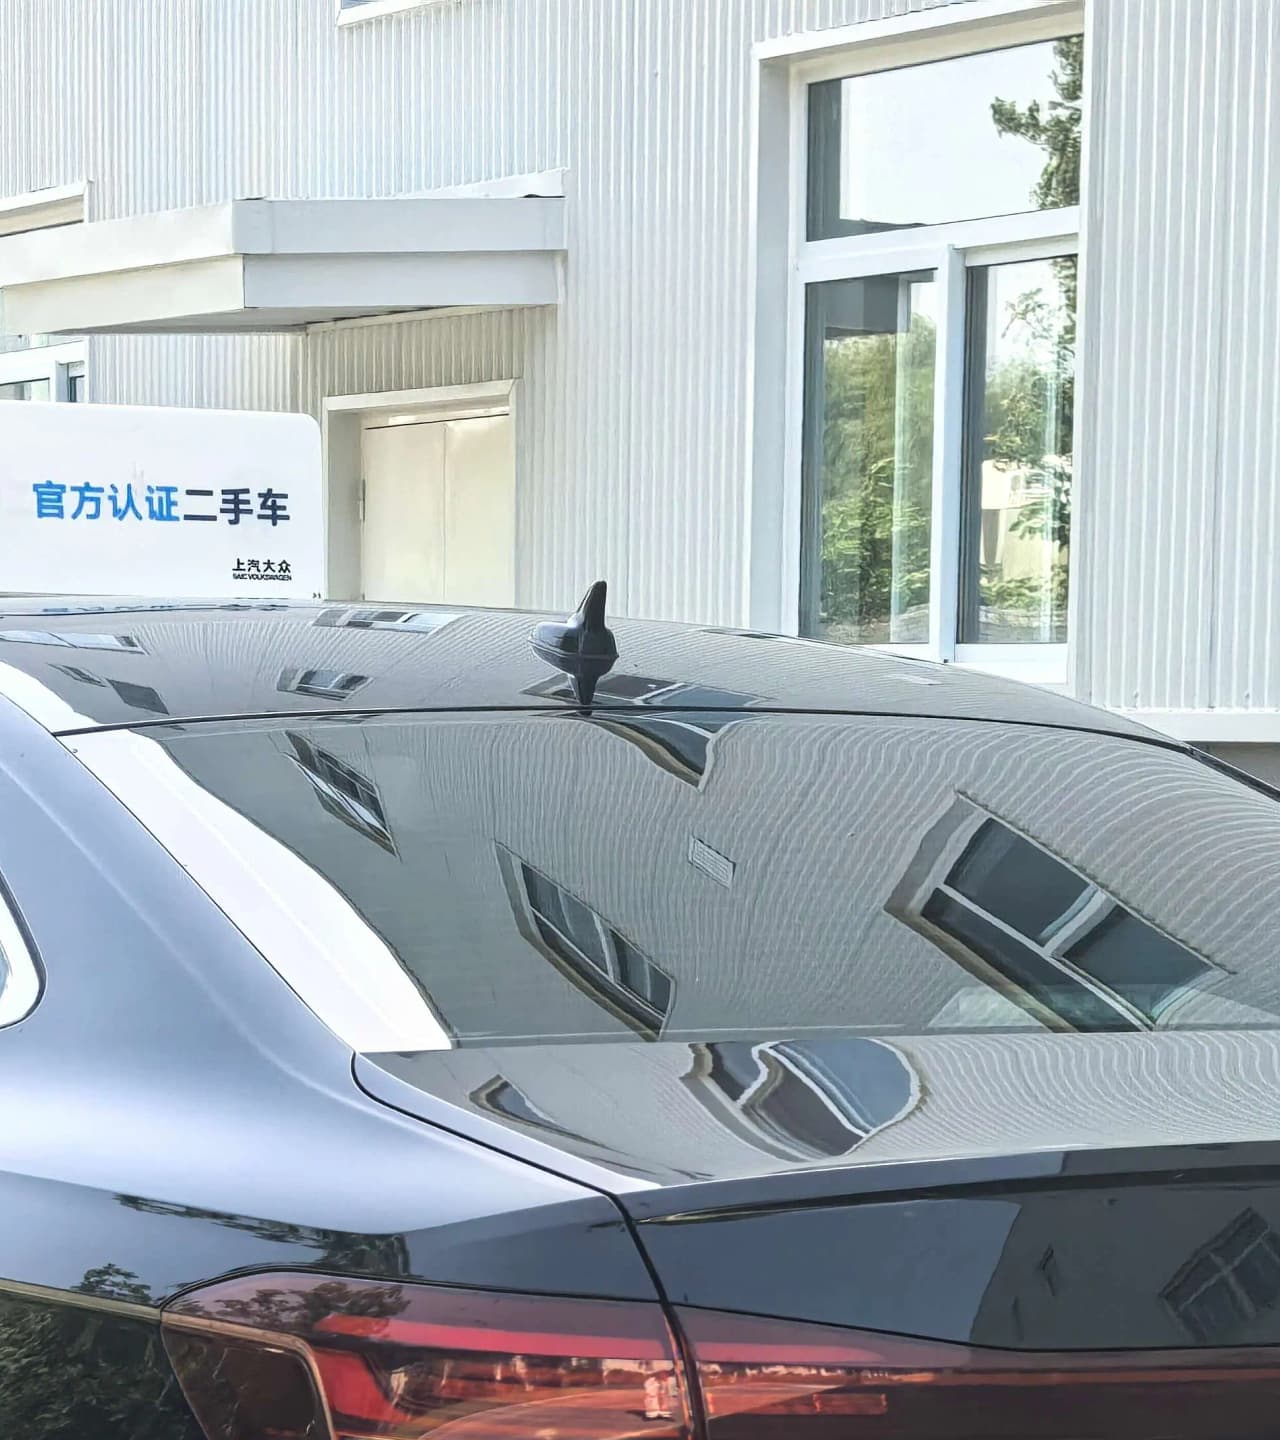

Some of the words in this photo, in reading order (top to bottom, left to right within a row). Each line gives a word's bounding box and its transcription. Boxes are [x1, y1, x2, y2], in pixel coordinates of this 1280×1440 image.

[32, 480, 291, 527] 官方认证二手车
[232, 557, 291, 573] 上汽大众
